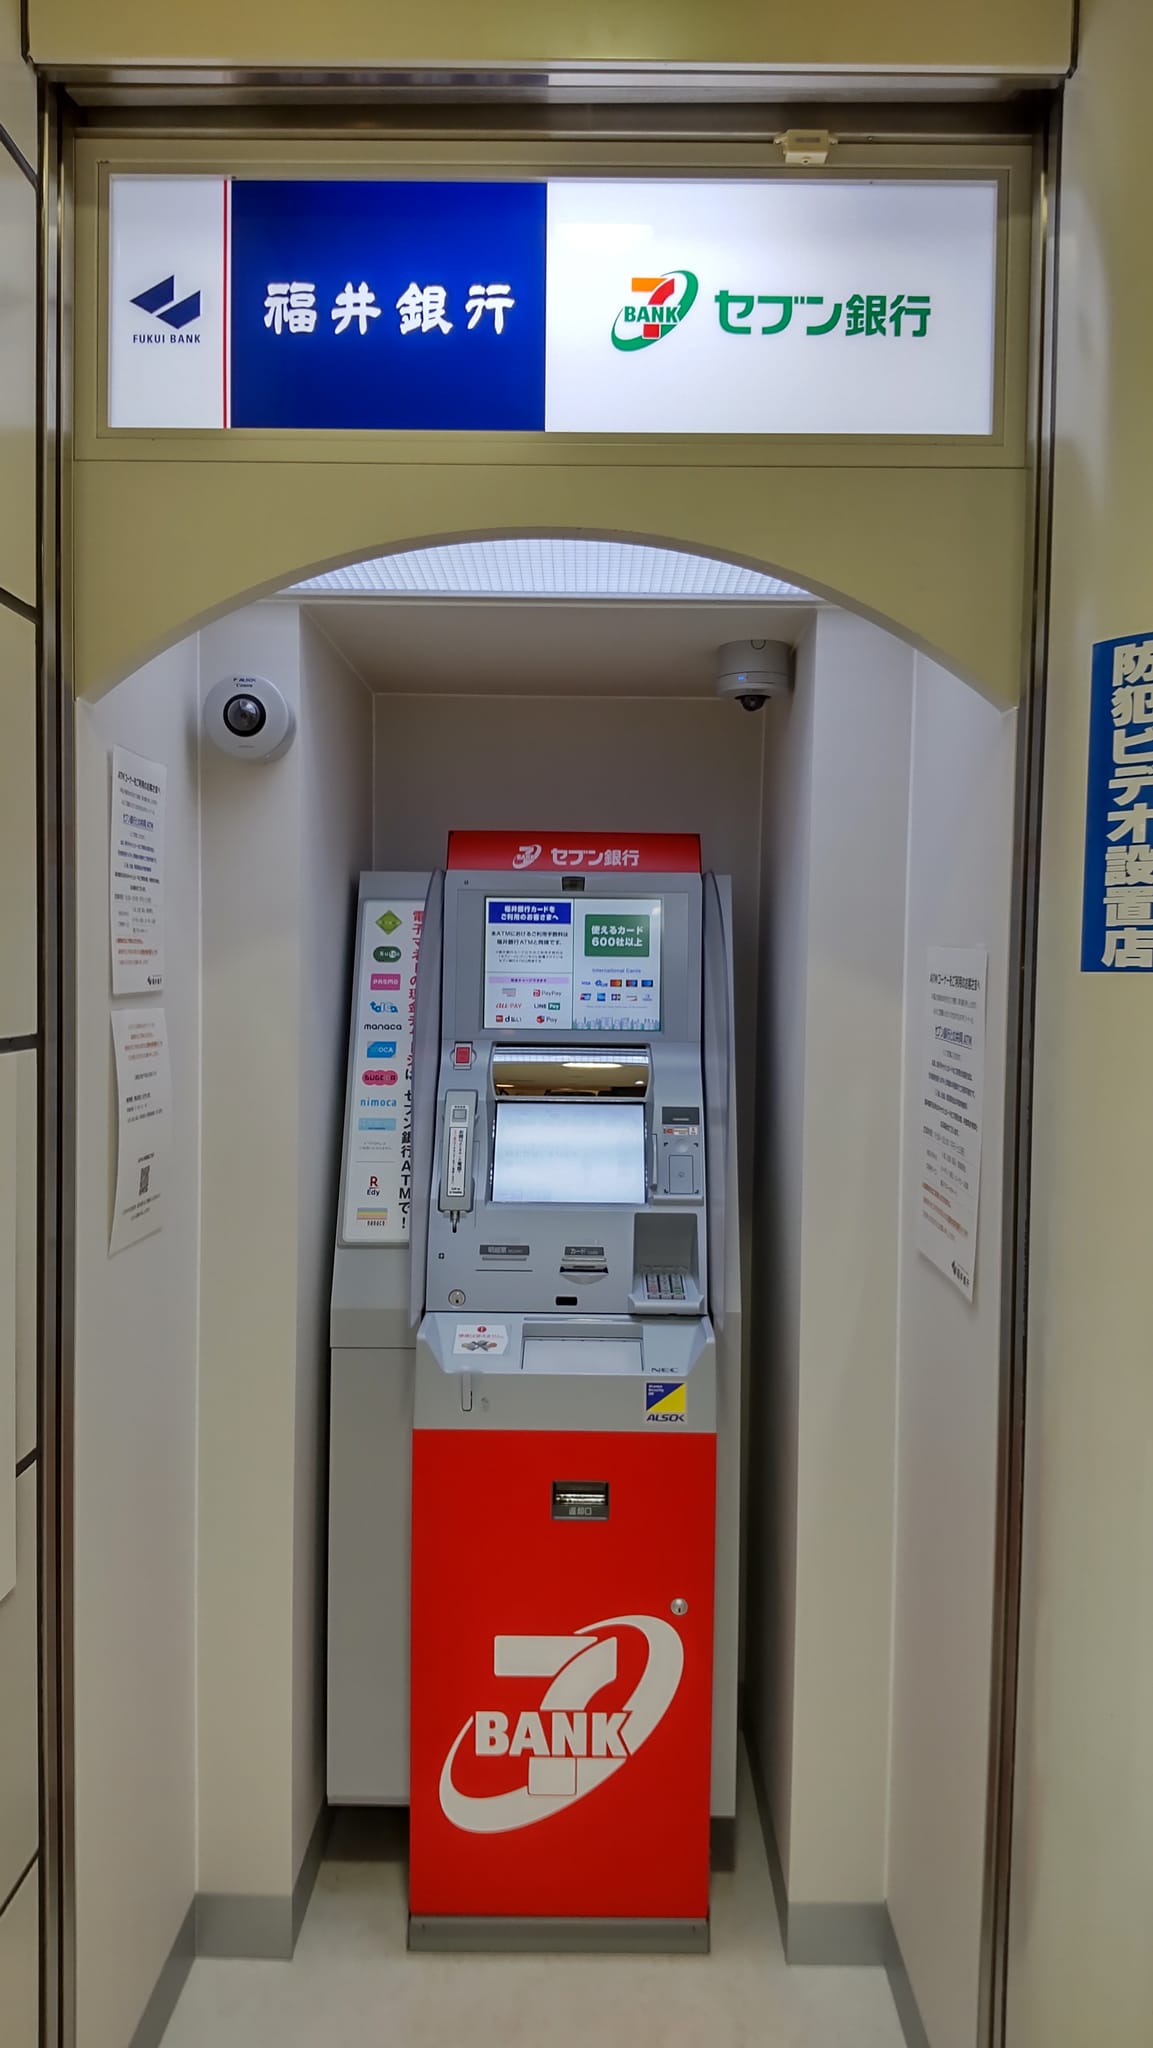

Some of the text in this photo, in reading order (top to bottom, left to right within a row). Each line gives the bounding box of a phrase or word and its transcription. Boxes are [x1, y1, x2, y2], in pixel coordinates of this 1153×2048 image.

[264, 281, 515, 335] 福井銀行
[715, 290, 931, 337] セブン銀行
[624, 306, 679, 323] BANK
[133, 334, 201, 344] FUKUI BANK
[1101, 639, 1153, 968] 防犯ビデオ設置店
[551, 848, 640, 866] セブン銀行
[591, 925, 644, 936] 使えるカード
[591, 937, 643, 947] 600社以上
[364, 1023, 402, 1031] manaca
[360, 1098, 397, 1107] nimoca
[370, 1176, 378, 1187] R
[366, 1188, 380, 1197] Edy
[647, 1414, 685, 1422] ALSOK
[475, 1711, 627, 1757] BANK
